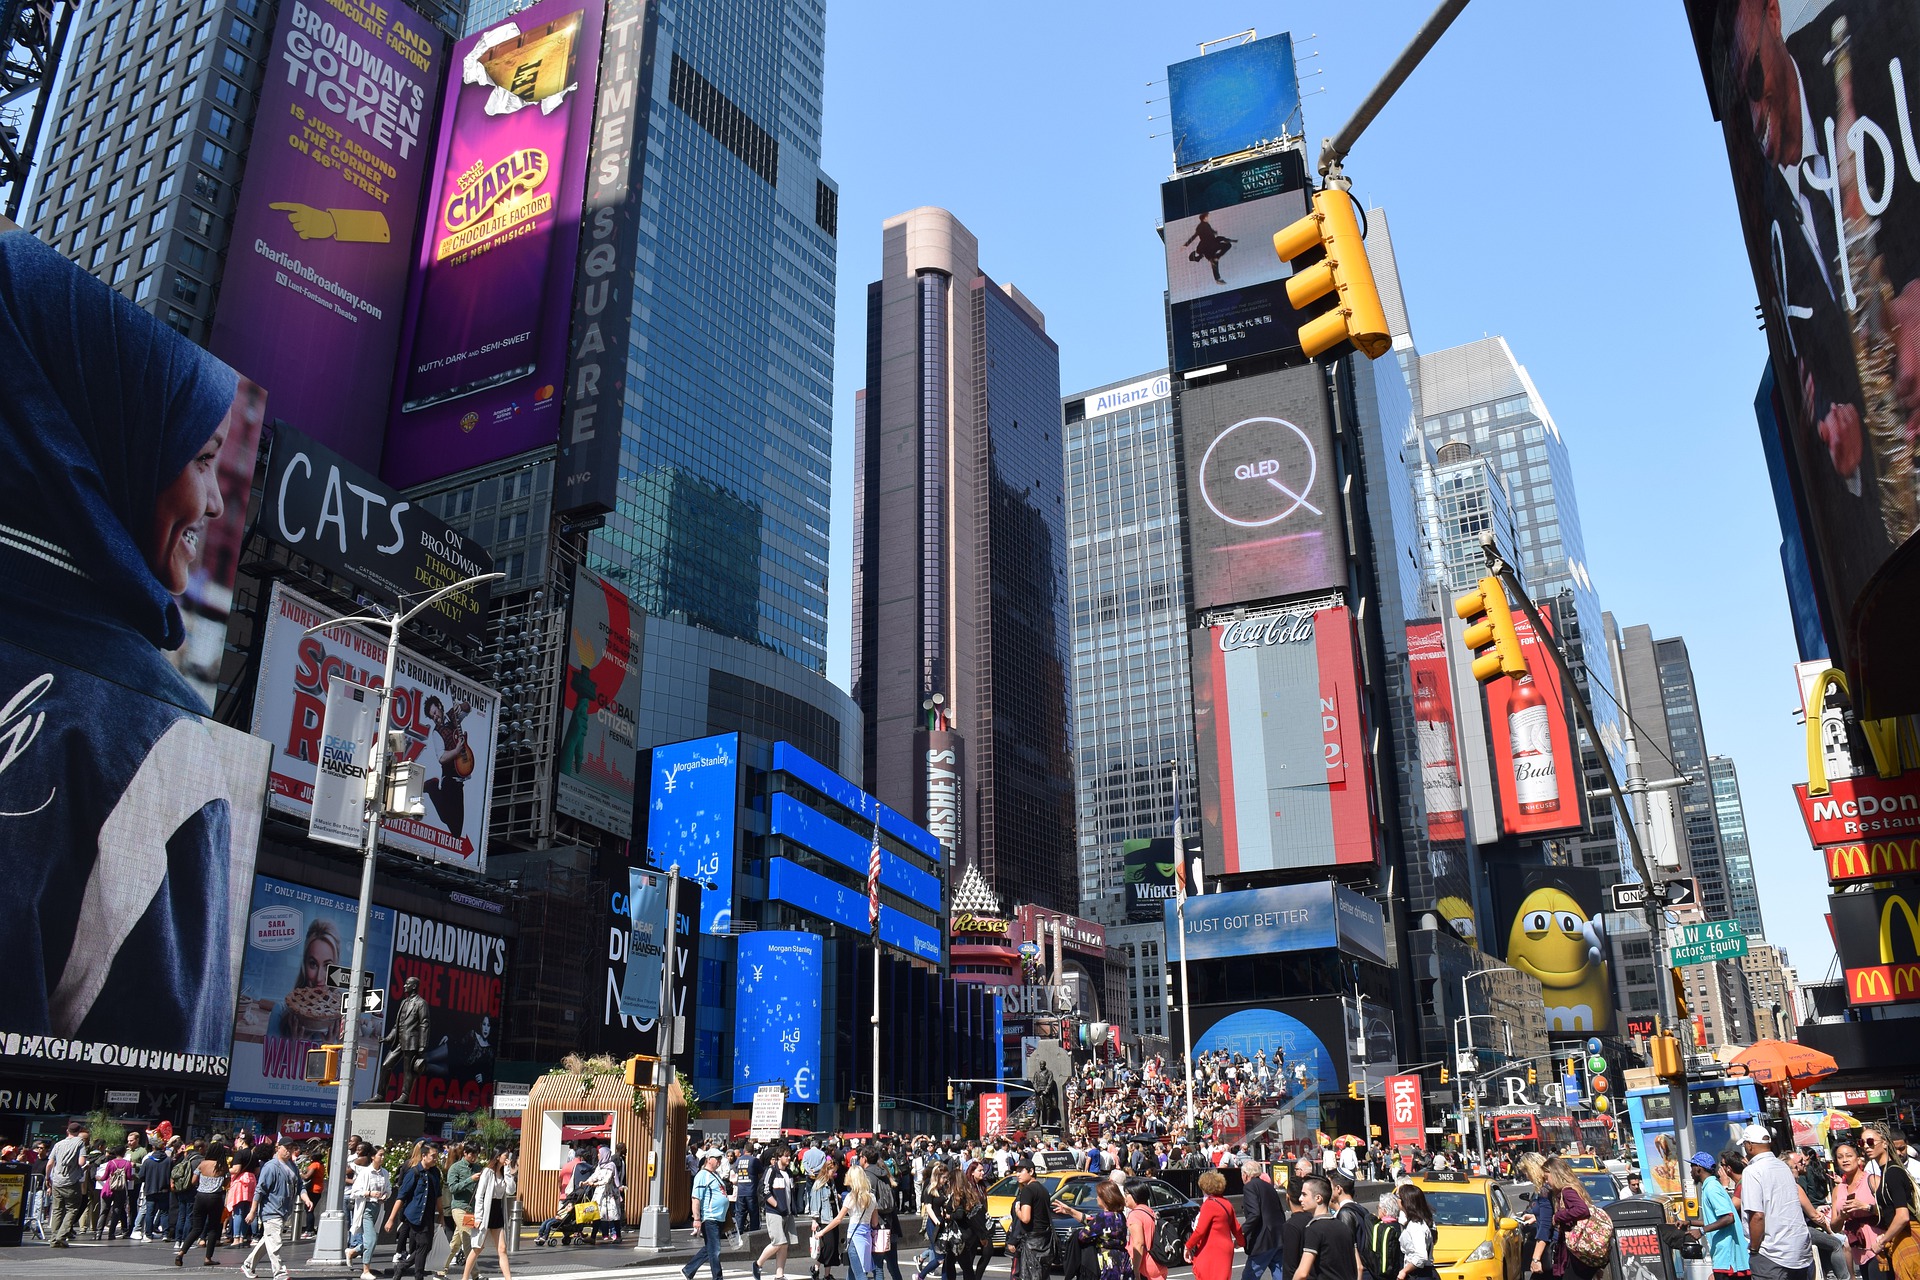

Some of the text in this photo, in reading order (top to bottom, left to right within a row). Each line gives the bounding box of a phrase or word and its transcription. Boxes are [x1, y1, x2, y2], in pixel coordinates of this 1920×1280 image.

[392, 21, 433, 57] AND
[291, 1, 425, 111] BROADWAY'S
[386, 32, 431, 74] FACTORY
[286, 30, 421, 132] GOLDEN
[283, 51, 417, 160] TICKET
[599, 15, 638, 186] TIMES
[290, 103, 397, 180] IS JUST AROUND
[303, 126, 382, 186] THE CORNER
[288, 135, 308, 156] ON
[343, 168, 390, 205] STREET
[1242, 169, 1283, 184] CHINESE
[447, 151, 543, 227] CHARLIE
[1243, 177, 1278, 191] WUSHU
[453, 196, 548, 251] CHOCOLATE FACTORY
[450, 221, 537, 267] THE NEW MUSICAL
[254, 238, 383, 321] CharlieOnBroadway.com
[333, 302, 358, 323] Theatre
[571, 207, 617, 445] SQUARE
[445, 352, 468, 366] DARK
[480, 331, 531, 355] SEMI-SWEET
[1096, 387, 1149, 411] Allianz
[567, 471, 592, 487] NYC
[1234, 459, 1280, 480] QLED
[278, 452, 409, 554] CATS
[445, 529, 463, 550] ON
[420, 531, 482, 577] BROADWAY
[469, 599, 479, 614] 30
[599, 621, 612, 635] STOP
[627, 627, 640, 641] TEXT
[1219, 610, 1315, 652] Coca-Cola
[353, 635, 388, 665] WEBBER
[601, 648, 614, 664] WIN
[407, 662, 451, 696] BROADWAY
[597, 694, 635, 724] GLOBAL
[597, 708, 635, 739] CITIZEN
[325, 735, 356, 753] DEAR
[609, 730, 633, 749] FESTIVAL
[323, 746, 353, 764] EVAN
[673, 754, 729, 773] Morgan Stanley
[321, 758, 368, 780] HANSEN
[411, 822, 437, 843] GARDEN
[437, 831, 463, 852] THEATRE
[265, 883, 385, 921] IF ONLY LIFE WERE AS EAS PIE
[1339, 898, 1354, 916] Better
[1354, 905, 1368, 921] drives
[258, 928, 295, 938] BAREILLES
[268, 920, 286, 928] SARA
[633, 919, 653, 935] DEAR
[953, 912, 1010, 933] Reese's
[1187, 909, 1309, 934] JUST GOT BETTER
[1686, 922, 1738, 942] W 46 St
[396, 912, 505, 976] BROADWAY'S
[633, 931, 651, 944] EVAN
[1676, 939, 1740, 959] Actors' Equity
[632, 943, 660, 957] HANSEN
[768, 945, 812, 955] Morgan Stanley
[1700, 953, 1717, 961] Corner
[448, 968, 501, 1018] THING
[1628, 1022, 1652, 1033] TALK
[1215, 1030, 1297, 1053] BETTER
[20, 1035, 93, 1062] EAGLE
[100, 1042, 228, 1077] OUTFITTERS
[1393, 1079, 1416, 1123] tkts
[1438, 1173, 1454, 1181] 3N55
[1616, 1227, 1657, 1237] BROADWAY'S
[1619, 1235, 1658, 1248] SURE
[1620, 1245, 1660, 1256] THING
